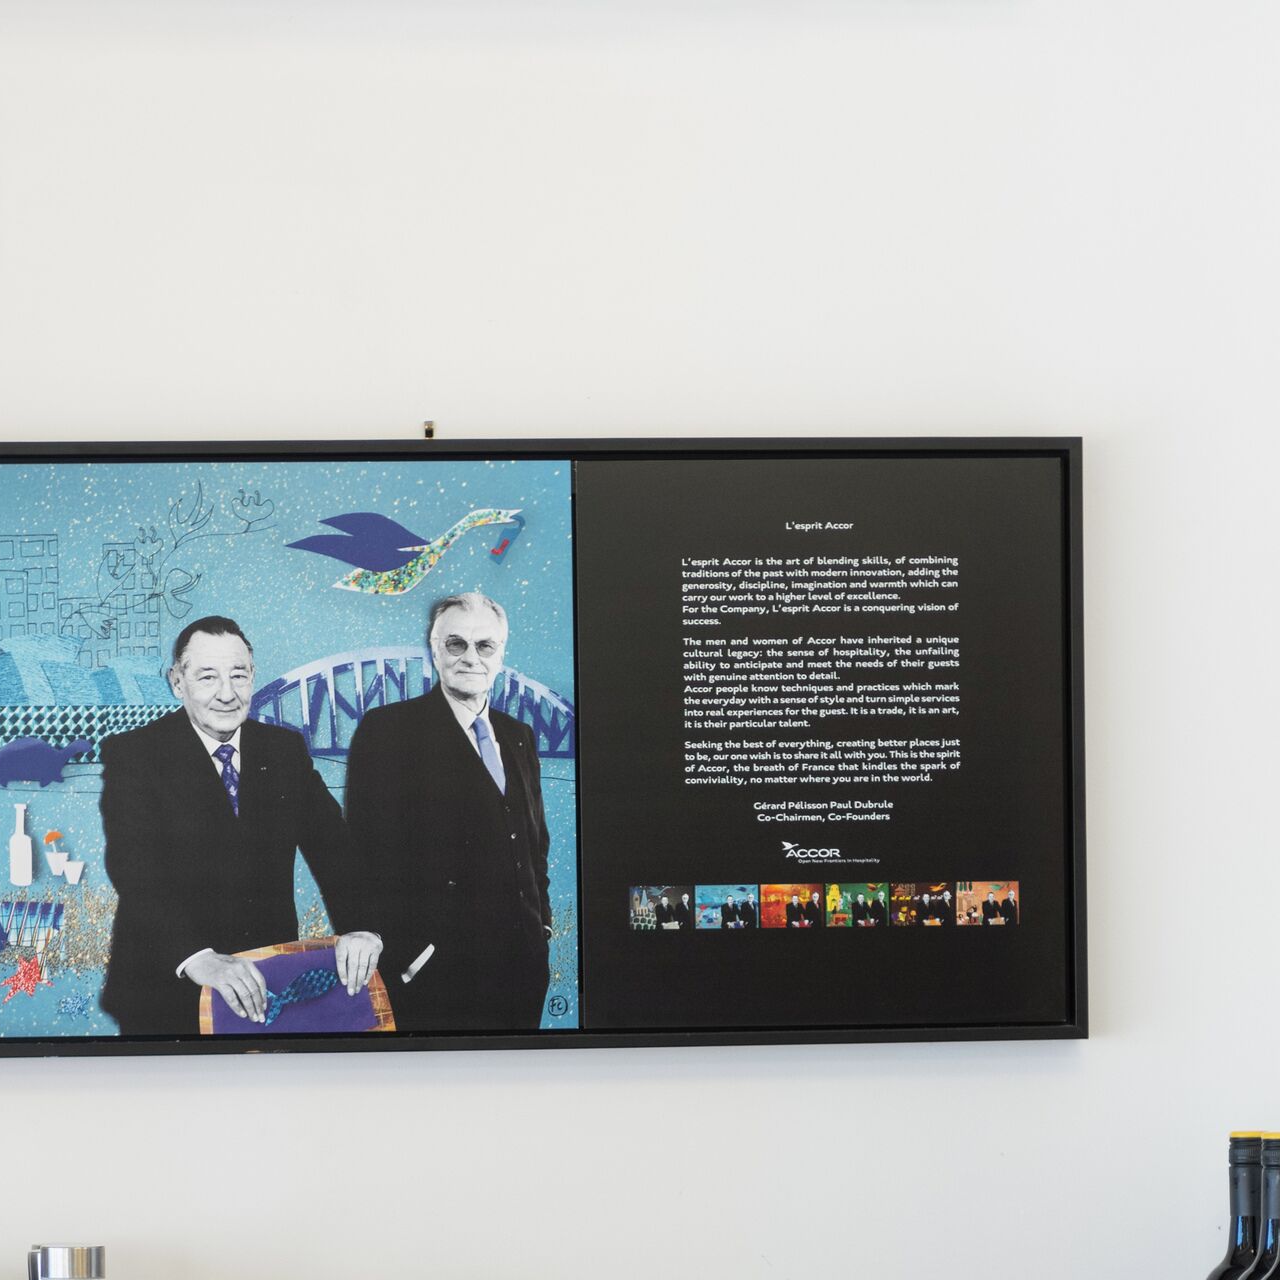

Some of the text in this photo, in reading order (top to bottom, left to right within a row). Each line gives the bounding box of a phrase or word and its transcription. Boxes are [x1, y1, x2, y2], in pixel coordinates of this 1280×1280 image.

[785, 521, 854, 532] L'esprit Accor
[681, 557, 720, 569] L'esprit
[722, 557, 752, 566] Accor
[754, 557, 763, 566] is
[765, 556, 783, 566] the
[803, 556, 814, 565] of
[817, 556, 860, 568] blending
[861, 555, 892, 566] skills,
[894, 555, 906, 565] of
[908, 555, 959, 567] combining
[681, 567, 959, 580] traditions of the past with modern innovation, adding the
[681, 581, 736, 592] generosity,
[738, 580, 789, 592] discipline,
[791, 580, 847, 591] imagination
[849, 579, 867, 588] and
[869, 579, 908, 588] warmth
[909, 579, 939, 588] which
[681, 595, 708, 604] carry
[728, 592, 754, 601] work
[755, 591, 767, 601] to
[775, 592, 806, 604] higher
[807, 591, 833, 601] level
[834, 591, 846, 600] of
[846, 591, 901, 600] excellence.
[753, 799, 894, 810] Gérard Pélisson Paul Dubrule
[756, 811, 891, 823] Co-Chairmen, Co-Founders
[786, 848, 841, 858] ACCOR
